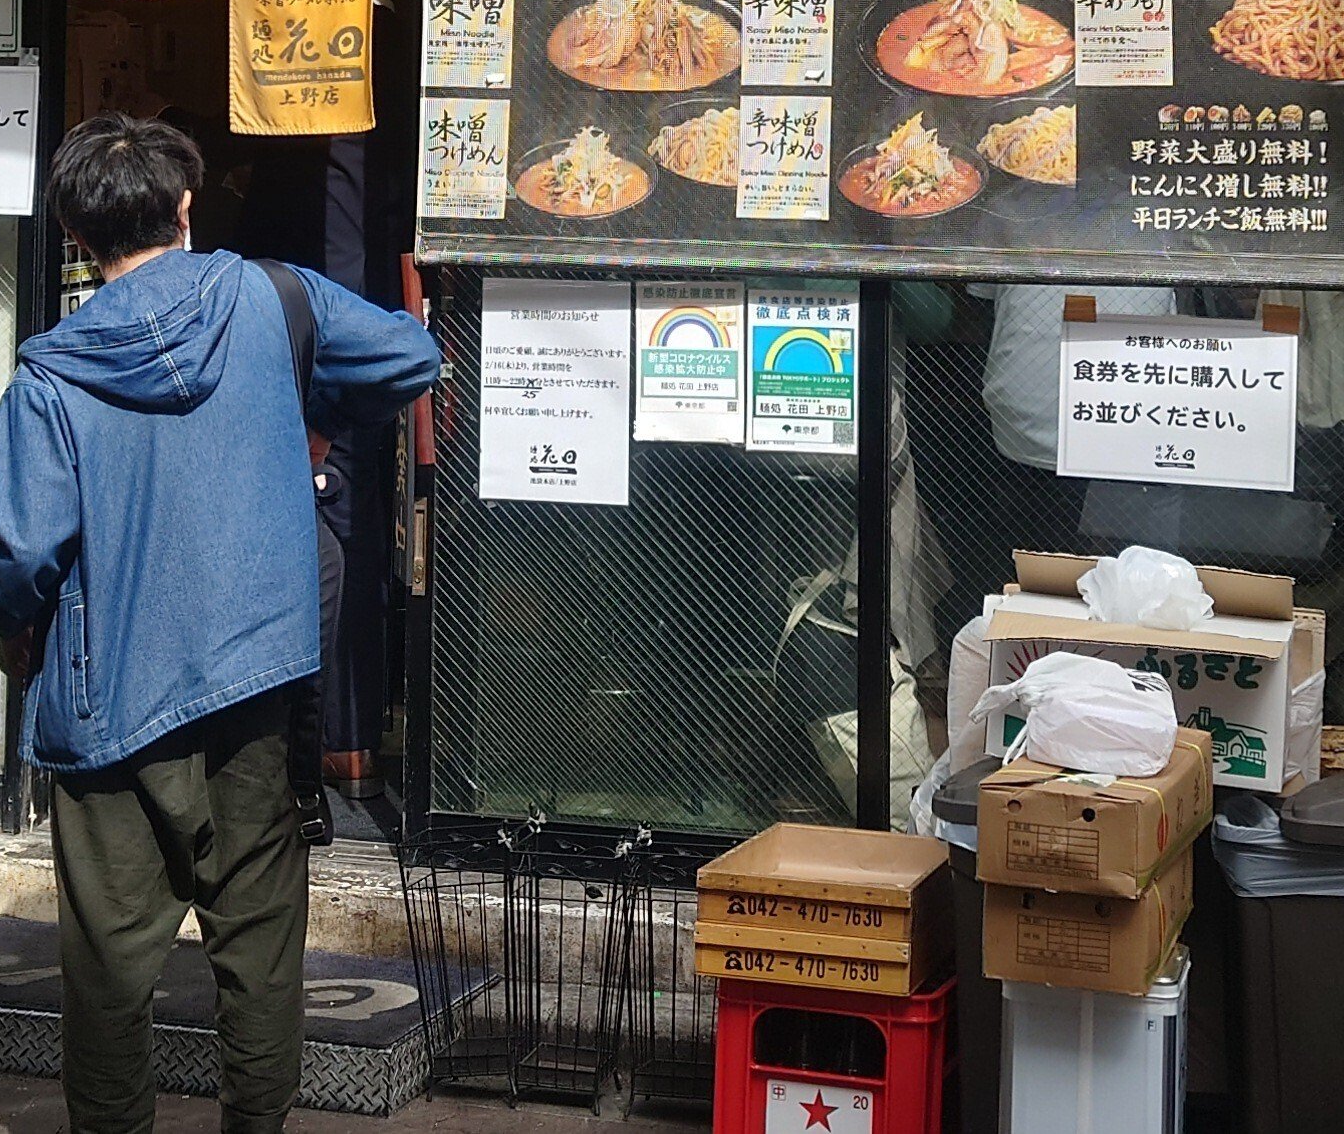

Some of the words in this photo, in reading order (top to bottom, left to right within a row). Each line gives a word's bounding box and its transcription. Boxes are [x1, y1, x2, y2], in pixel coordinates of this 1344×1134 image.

[278, 85, 340, 107] 上野店
[428, 108, 488, 144] 味噌
[745, 107, 819, 138] 辛味噌
[427, 141, 504, 168] つけめん
[746, 136, 823, 163] つけめん
[642, 287, 737, 300] 感染防止徹底宣言
[510, 309, 600, 323] 営業時間のお知らせ
[756, 306, 851, 322] 徹底点検済
[1124, 335, 1233, 352] お客様へのお願い
[648, 352, 731, 365] 新型コロナウイルス
[654, 364, 726, 376] 感染拡大防止中
[1073, 359, 1286, 391] 食券を先に購入して
[787, 403, 809, 415] 花田
[814, 404, 848, 417] 上野店
[1072, 401, 1247, 433] お並びください。
[853, 1095, 869, 1111] 20
